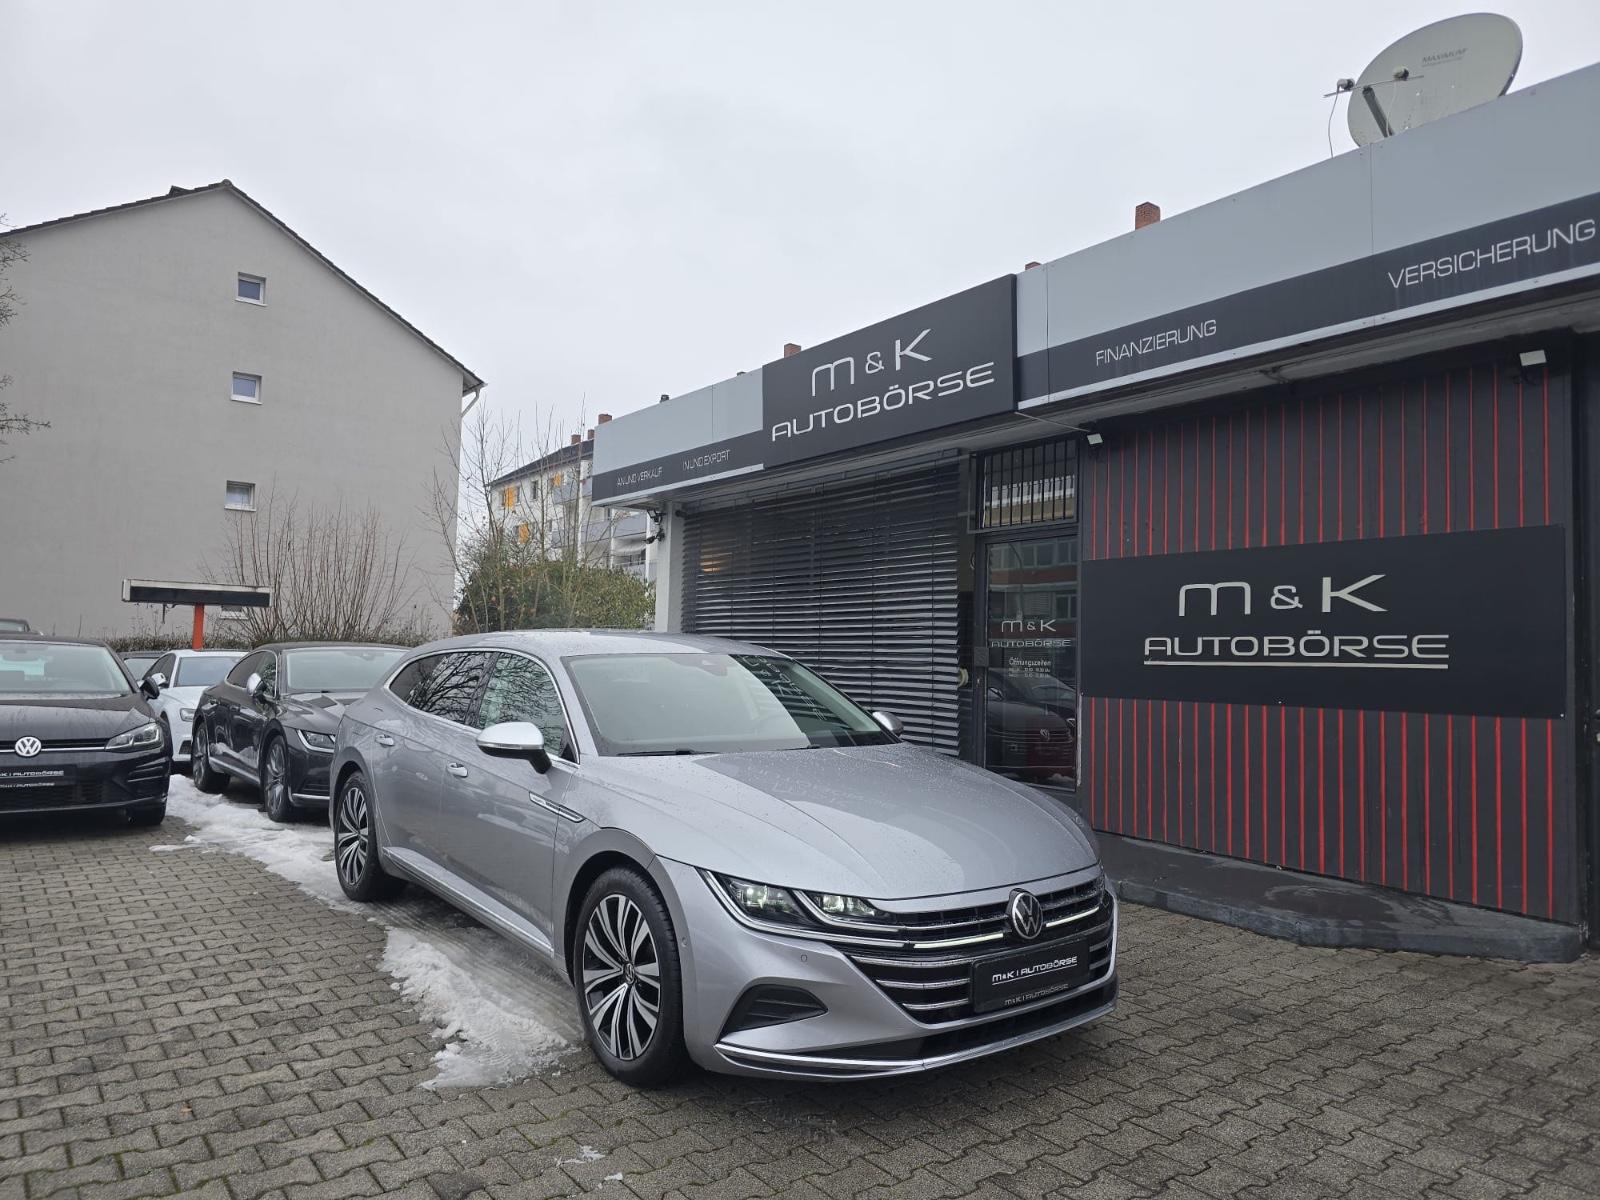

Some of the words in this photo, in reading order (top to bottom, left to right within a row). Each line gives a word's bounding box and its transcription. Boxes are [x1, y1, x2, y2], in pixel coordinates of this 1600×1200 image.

[1388, 219, 1595, 288] VERSICHERUNG
[865, 351, 884, 374] &
[895, 328, 933, 371] K
[1096, 320, 1217, 366] FINANZIERUNG
[772, 361, 995, 442] AUTOBÖRSE
[1270, 585, 1303, 610] &
[1321, 574, 1388, 613] K
[991, 638, 1072, 648] AUTOBÖRSE
[1026, 621, 1037, 631] &
[1040, 619, 1057, 632] K
[1144, 629, 1449, 659] AUTOBÖRSE
[1020, 956, 1078, 976] AUTOBÖRSE
